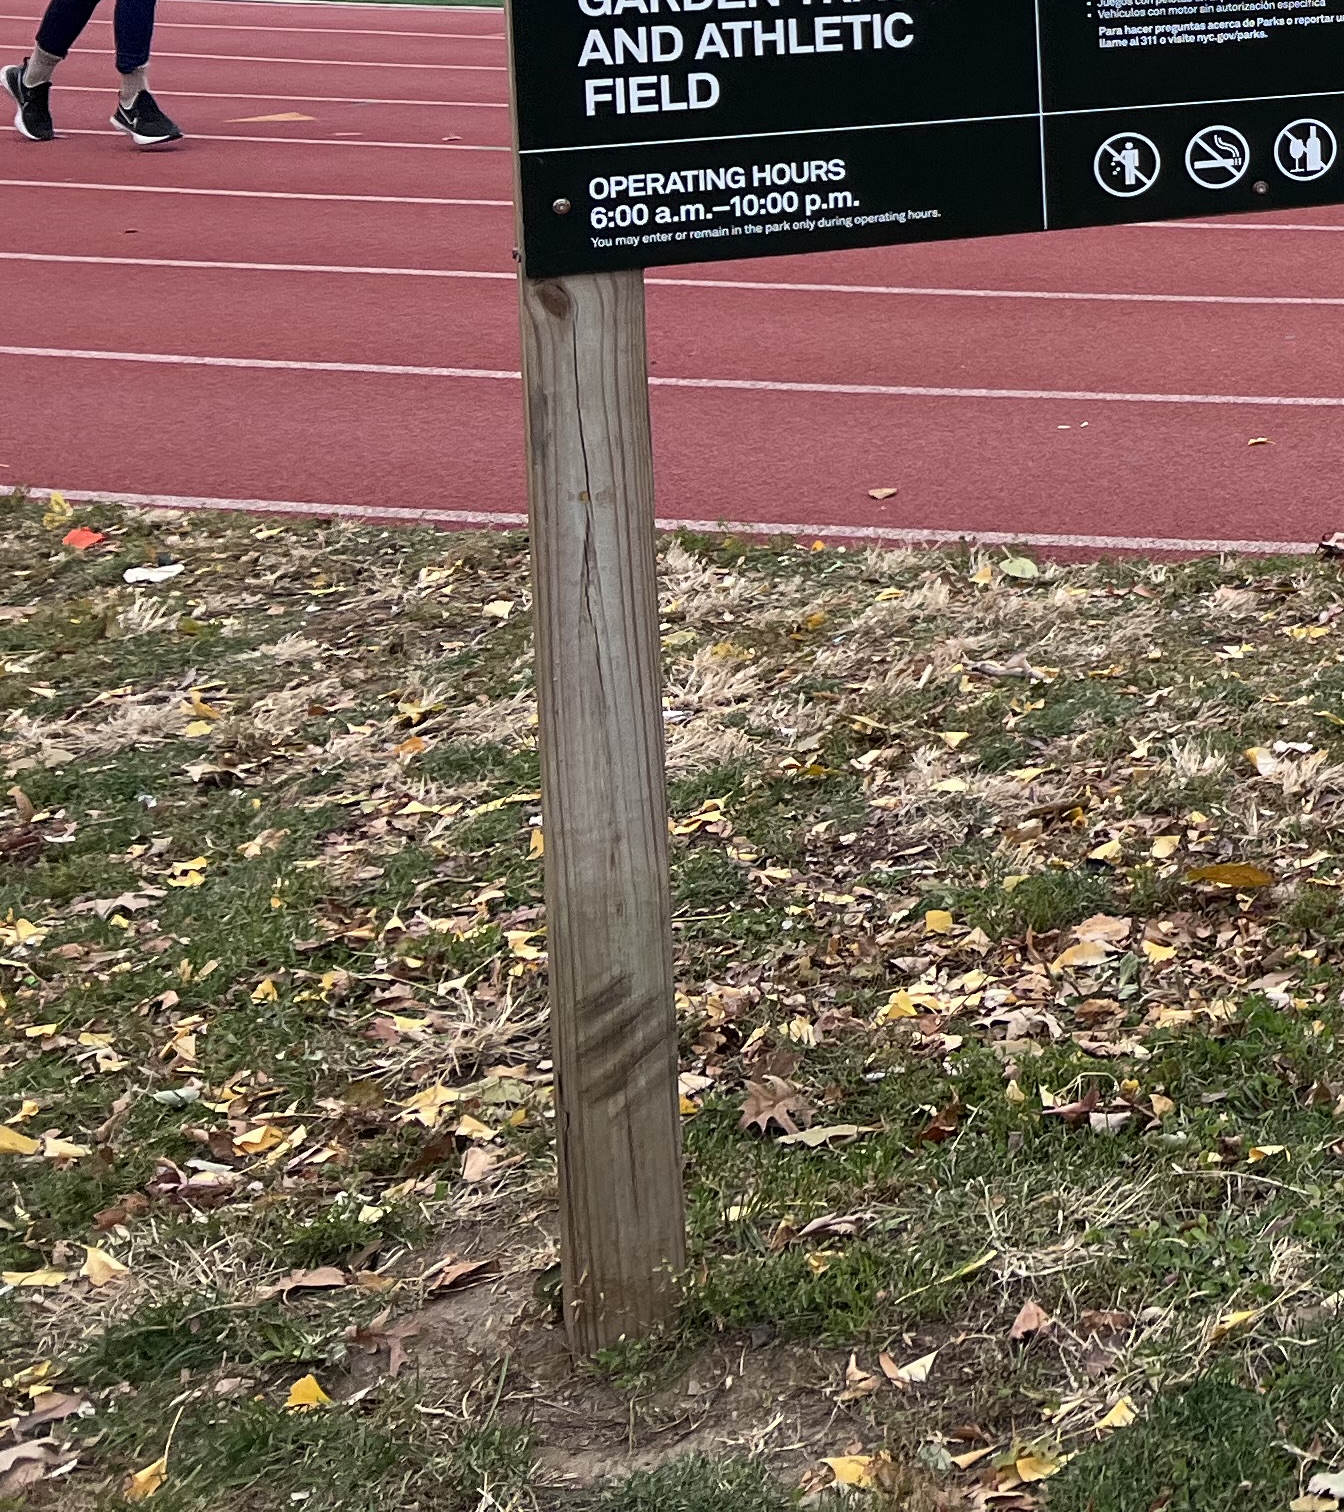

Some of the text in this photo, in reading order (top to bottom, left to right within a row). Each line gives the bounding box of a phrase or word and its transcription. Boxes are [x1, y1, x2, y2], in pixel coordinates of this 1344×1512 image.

[577, 11, 914, 67] AND ATHLETIC
[584, 72, 720, 117] FIELD
[589, 158, 846, 200] OPERATING HOURS
[590, 190, 860, 230] 6:00 a.m.–10:00 p.m.
[590, 209, 942, 248] You may enter or remain in the park only during operating hours.
